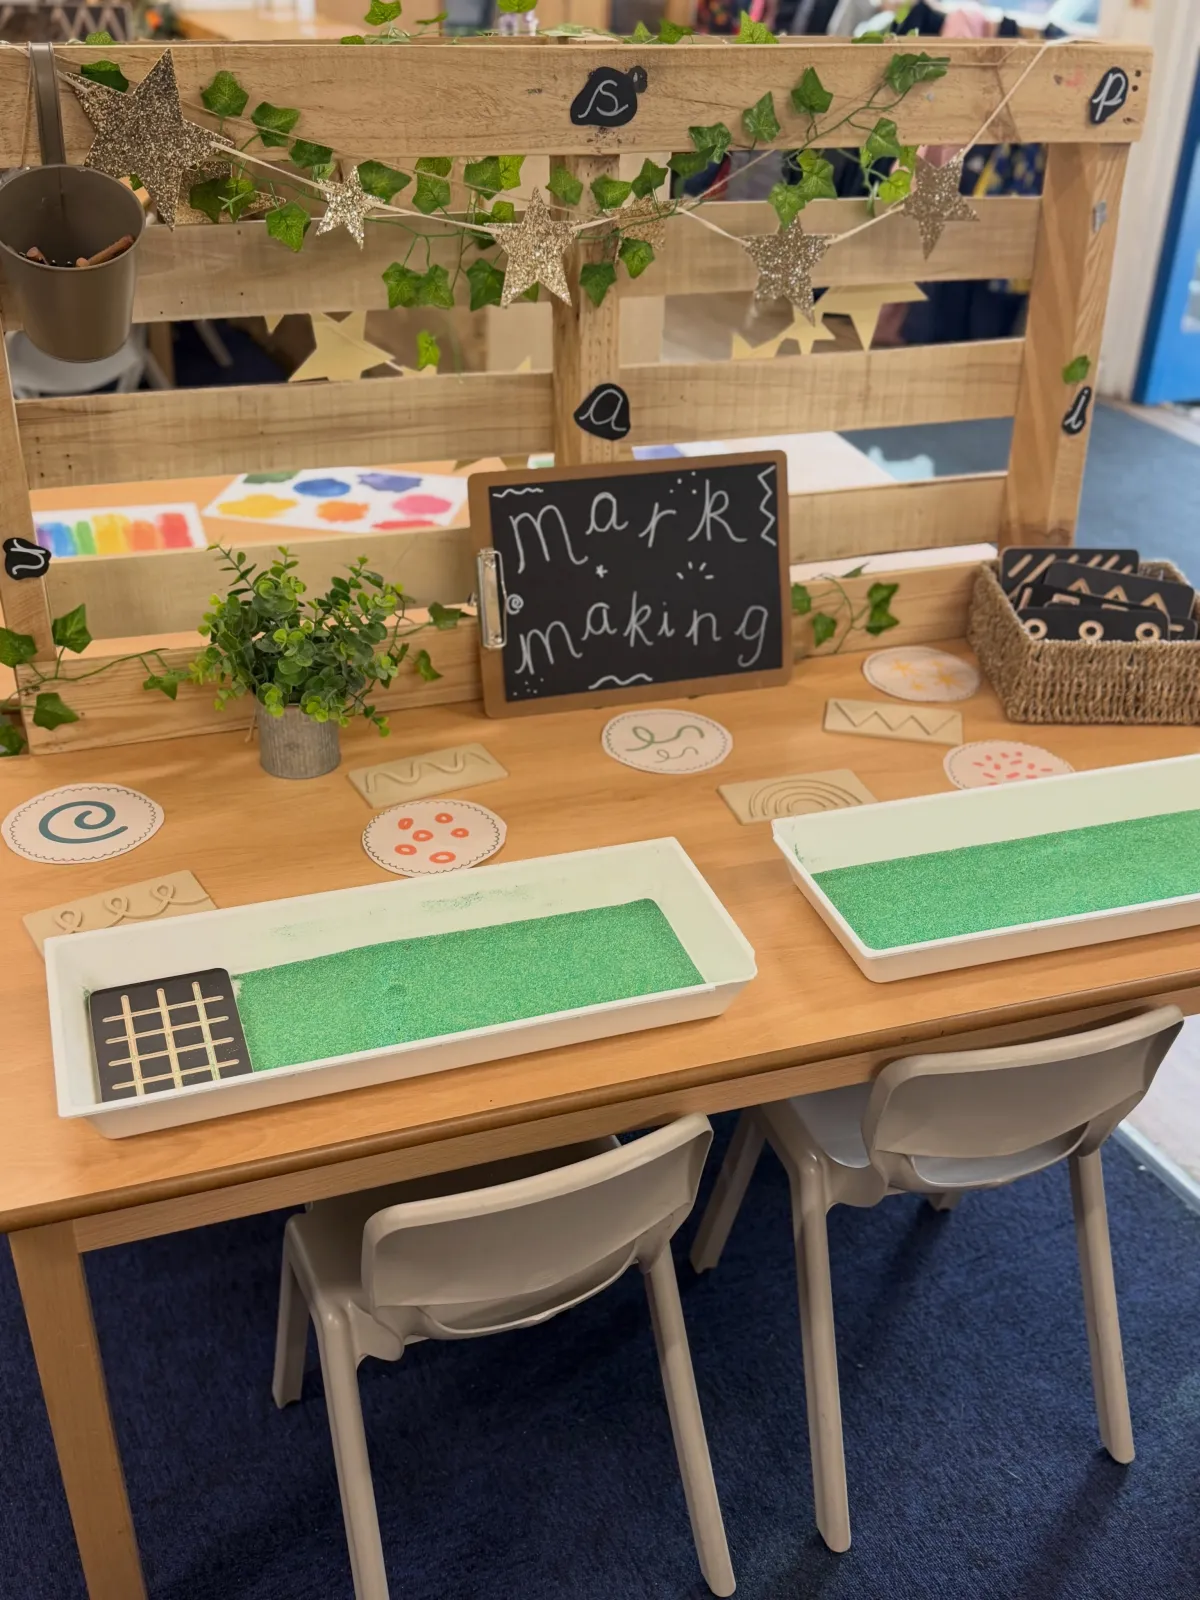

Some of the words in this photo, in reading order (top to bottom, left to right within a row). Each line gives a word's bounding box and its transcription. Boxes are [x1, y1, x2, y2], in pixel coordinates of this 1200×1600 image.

[1092, 72, 1126, 121] p
[578, 388, 627, 431] a
[1063, 389, 1089, 430] i
[508, 478, 748, 574] mark
[514, 590, 769, 675] making
